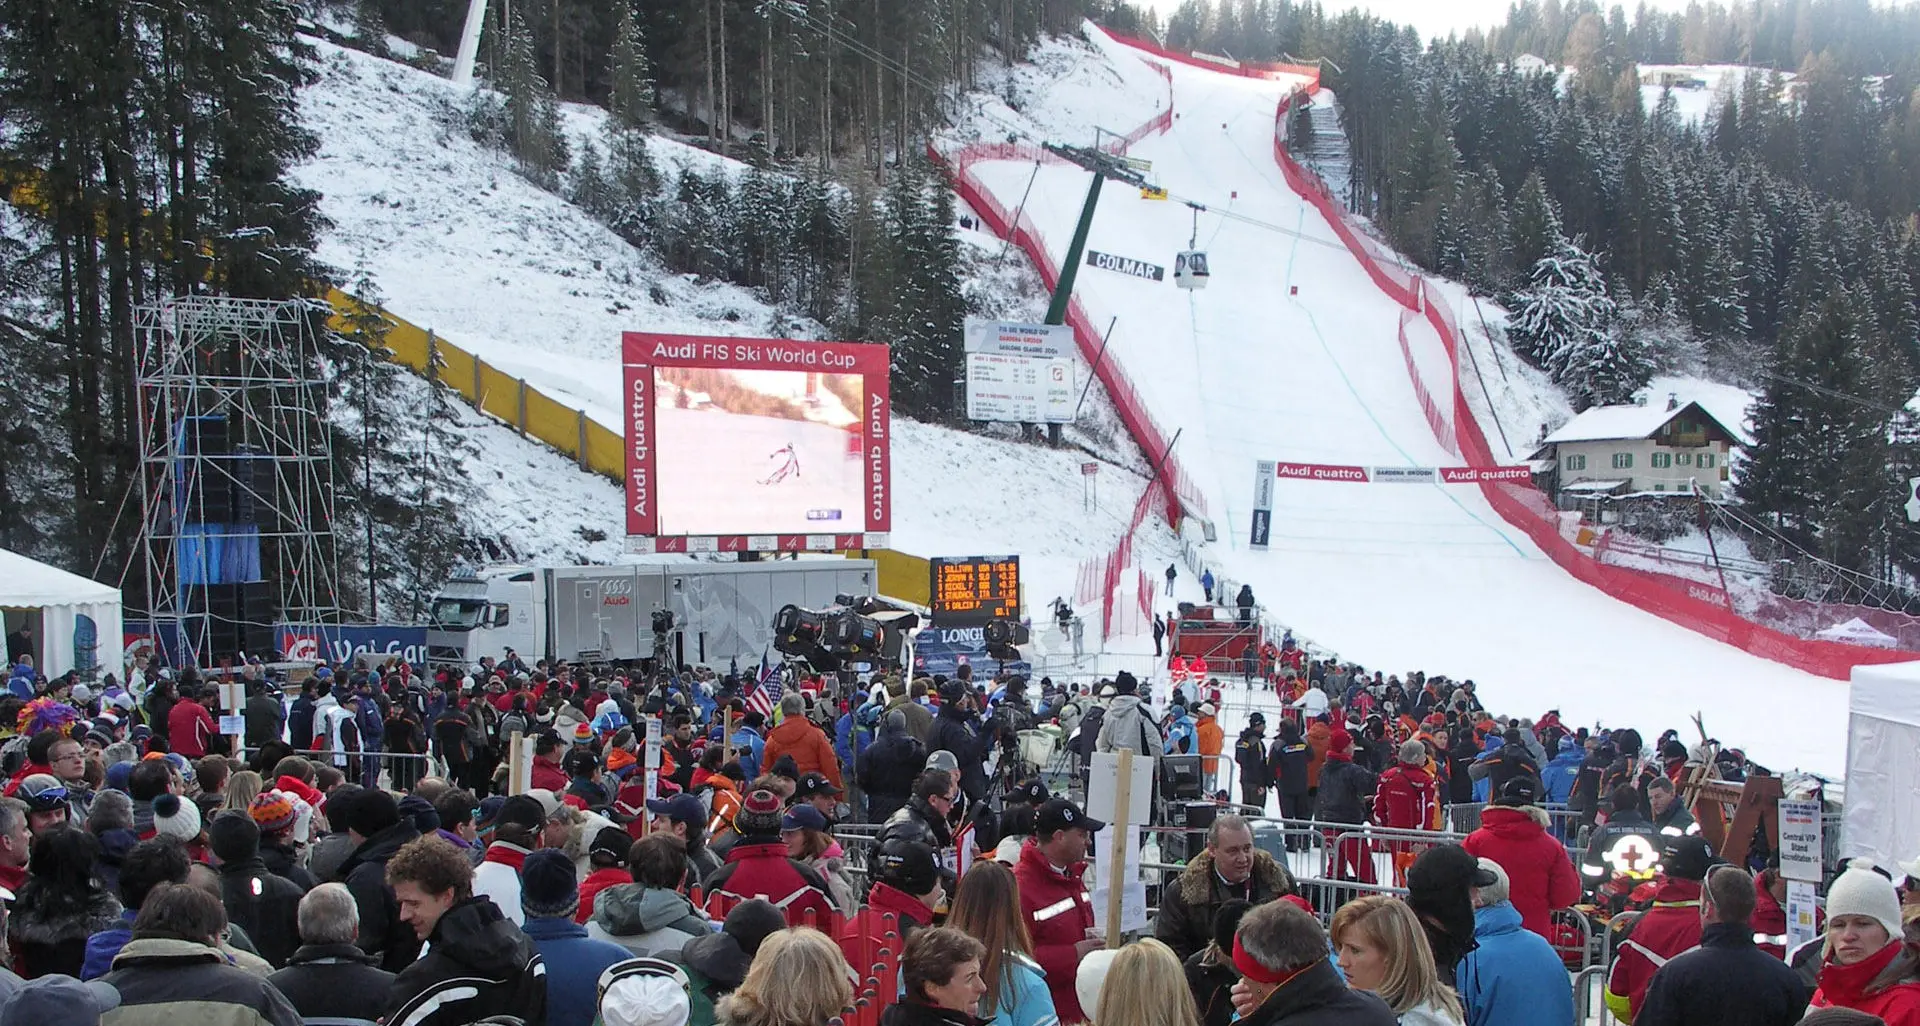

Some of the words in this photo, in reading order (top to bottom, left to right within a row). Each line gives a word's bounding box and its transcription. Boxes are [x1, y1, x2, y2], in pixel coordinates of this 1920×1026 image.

[1096, 253, 1156, 279] COLMAR
[653, 342, 697, 359] Audi
[703, 344, 729, 360] FIS
[735, 345, 761, 361] Ski
[766, 347, 816, 365] World
[822, 351, 856, 368] Cup
[633, 378, 646, 461] quattro
[871, 393, 884, 439] Audi
[1281, 465, 1310, 477] Audi
[1314, 469, 1363, 480] quattro
[1447, 469, 1478, 480] Audi
[1481, 469, 1529, 481] quattro
[633, 467, 647, 517] Audi
[872, 446, 883, 521] quattro
[604, 596, 629, 605] Audi
[941, 627, 984, 643] LONGI
[1783, 832, 1804, 841] Central
[1805, 834, 1816, 842] VIP
[1791, 843, 1808, 852] Stand
